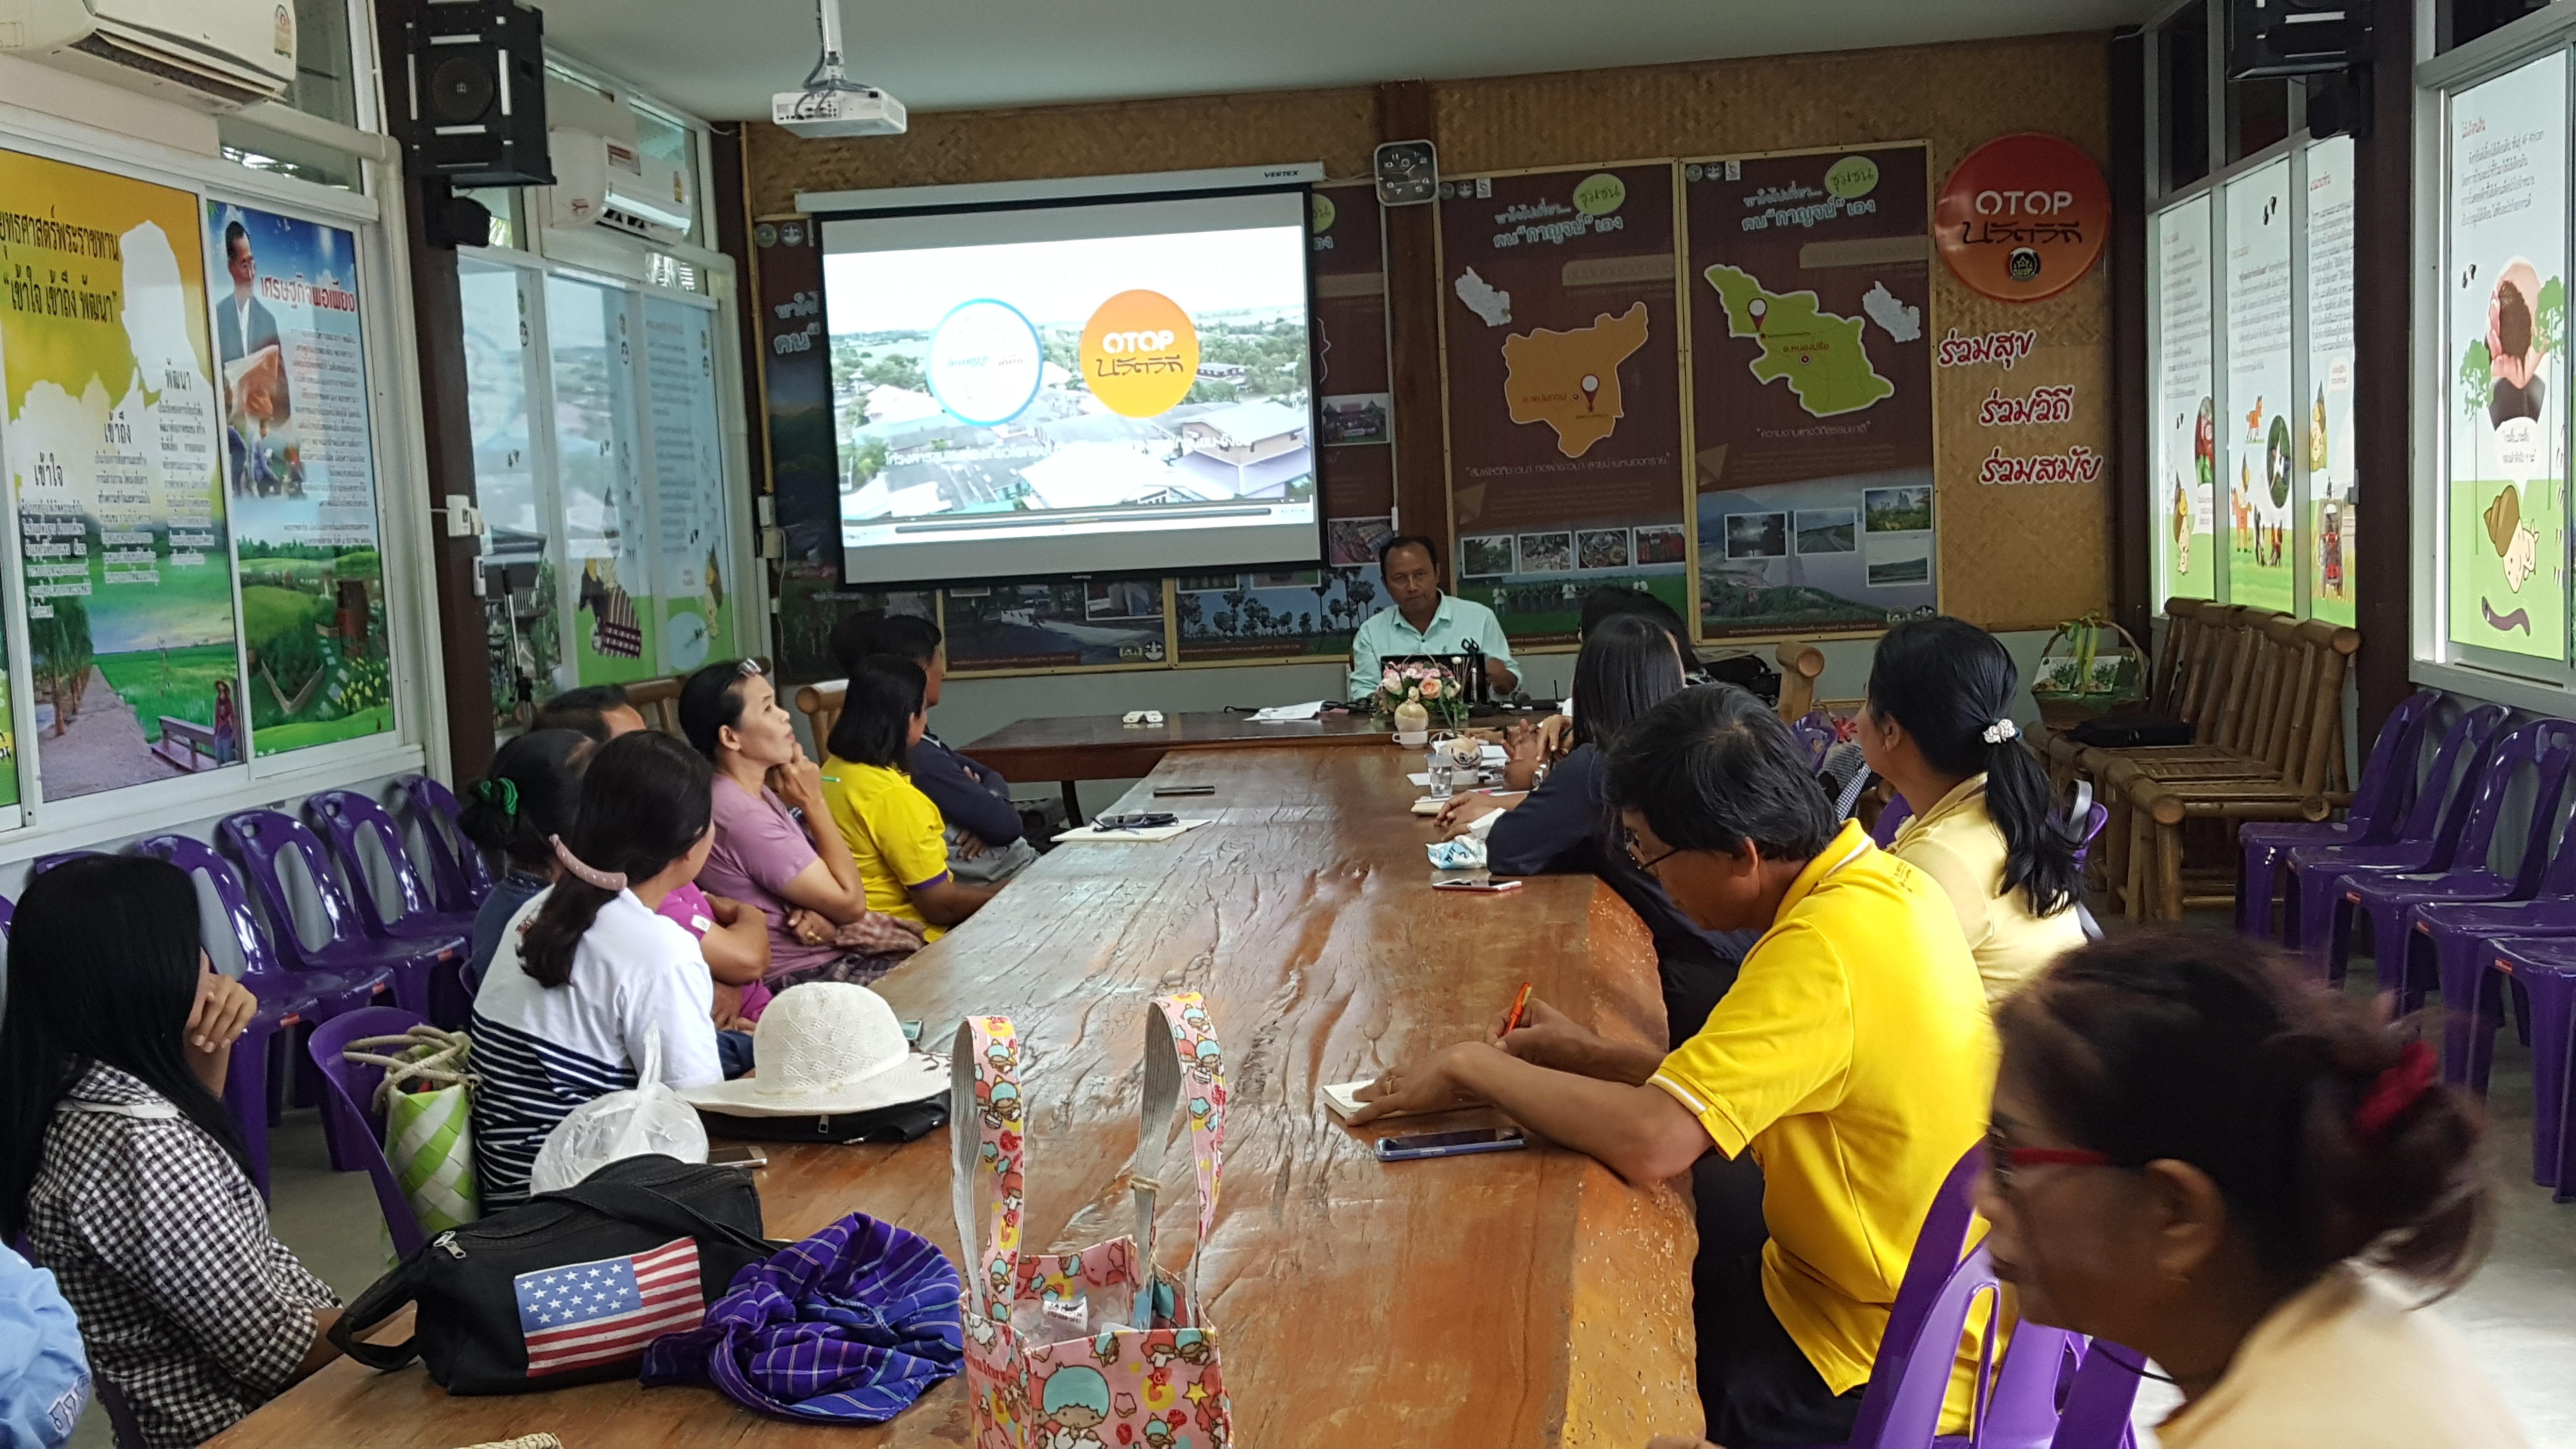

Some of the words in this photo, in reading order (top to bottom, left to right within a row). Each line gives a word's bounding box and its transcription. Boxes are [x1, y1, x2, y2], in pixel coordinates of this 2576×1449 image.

[1847, 199, 1876, 217] เอง
[1975, 191, 2073, 215] OTOP
[1595, 215, 1624, 232] เอง
[260, 273, 355, 313] เศรษฐกิจพอเพียง
[1102, 330, 1175, 354] OTOP
[1939, 330, 2034, 369] ร่วมสุข
[1980, 386, 2074, 425] ร่วมวิถี
[104, 410, 132, 445] เข้าถึง
[33, 451, 64, 487] เข้าใจ
[1980, 447, 2101, 484] ร่วมสมัย
